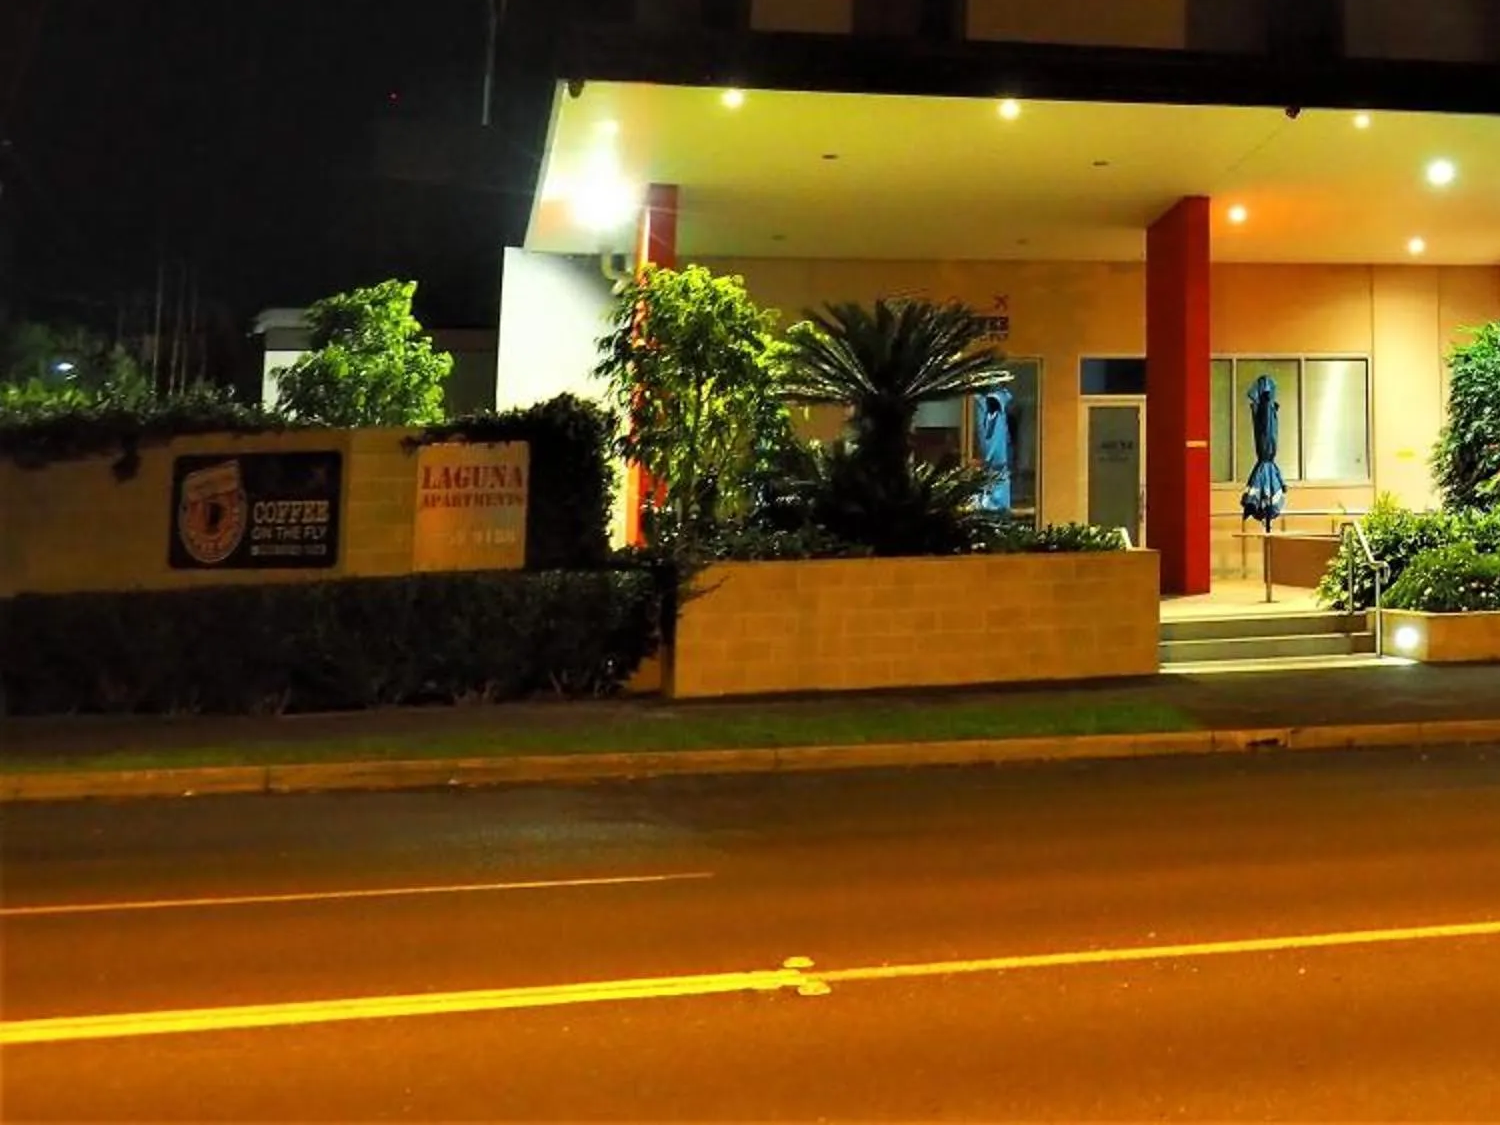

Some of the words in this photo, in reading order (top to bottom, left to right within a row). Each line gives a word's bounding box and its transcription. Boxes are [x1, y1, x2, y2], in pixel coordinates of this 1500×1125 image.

[422, 465, 524, 490] LAGUNA
[421, 492, 524, 508] APARTMENTS
[253, 500, 330, 524] COFFEE
[275, 525, 302, 540] THE
[303, 525, 328, 540] FLY
